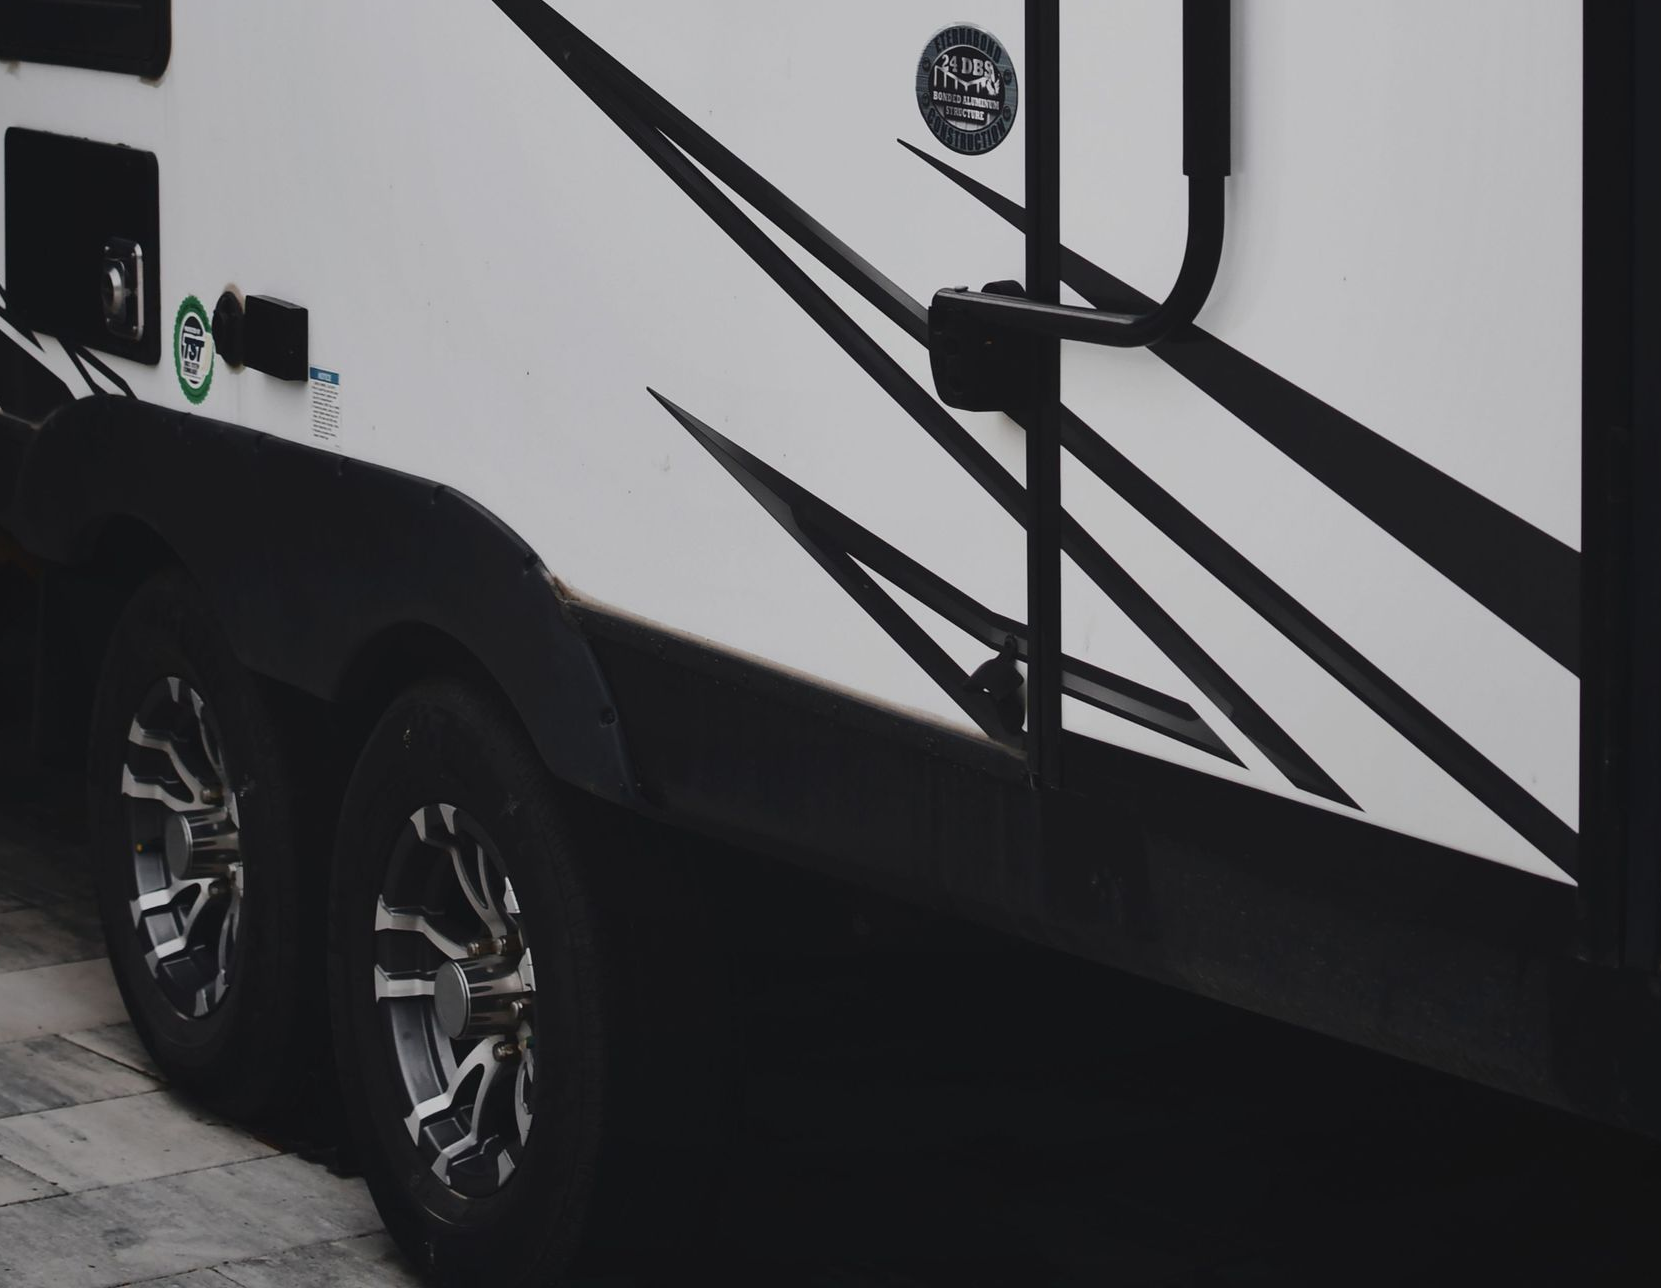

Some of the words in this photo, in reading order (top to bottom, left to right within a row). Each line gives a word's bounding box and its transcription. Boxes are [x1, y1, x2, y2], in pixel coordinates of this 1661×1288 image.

[935, 27, 1002, 63] ETERNABOND
[942, 54, 958, 72] 24
[961, 57, 993, 78] DBS
[933, 90, 962, 103] BONDED
[962, 96, 1000, 111] ALUMINUM
[946, 105, 985, 121] STRUCTURE
[927, 107, 1006, 152] CONSTRUCTION
[184, 337, 205, 362] TST
